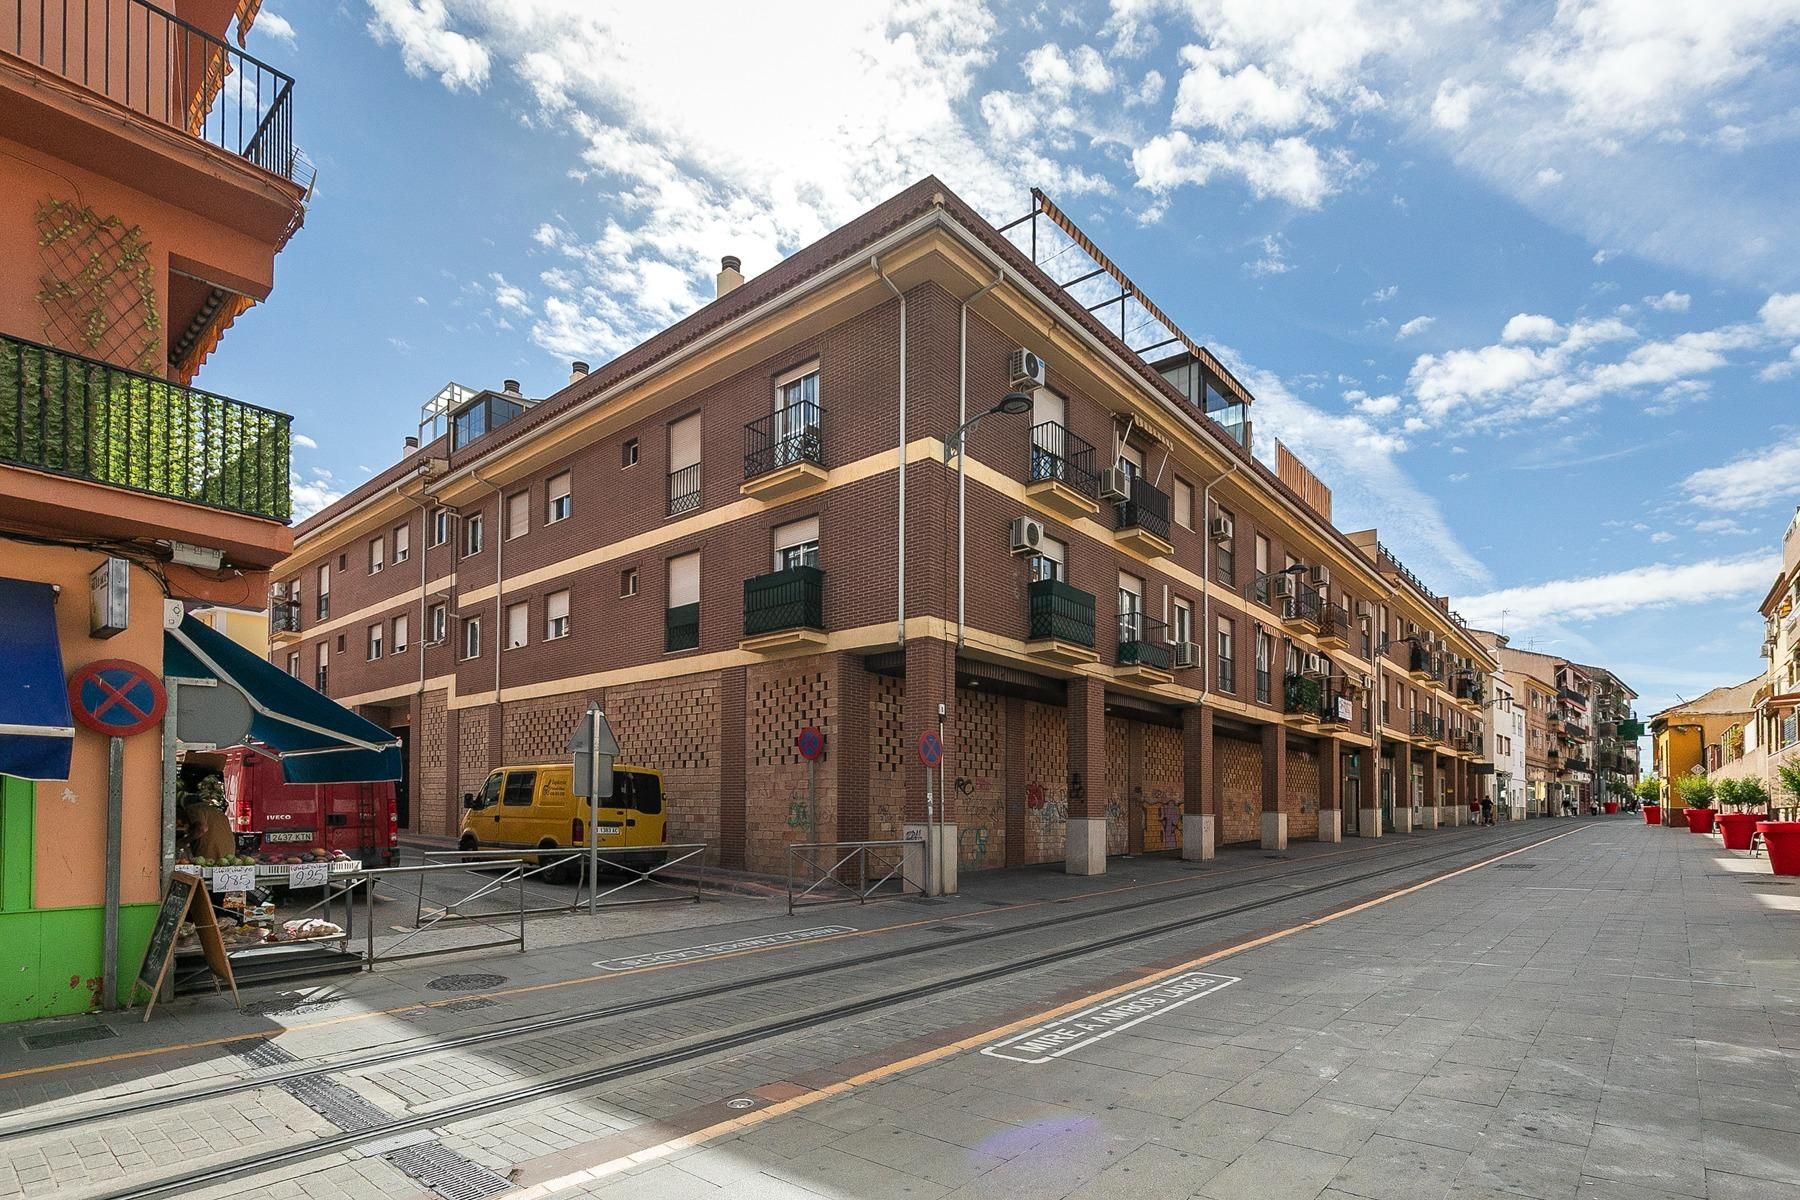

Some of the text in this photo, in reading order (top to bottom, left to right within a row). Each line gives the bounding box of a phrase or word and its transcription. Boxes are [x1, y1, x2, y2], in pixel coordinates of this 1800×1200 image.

[705, 938, 776, 951] AMBOS
[621, 950, 703, 966] LADOS
[1013, 977, 1216, 1053] MIRE A AMBOS LADOS
